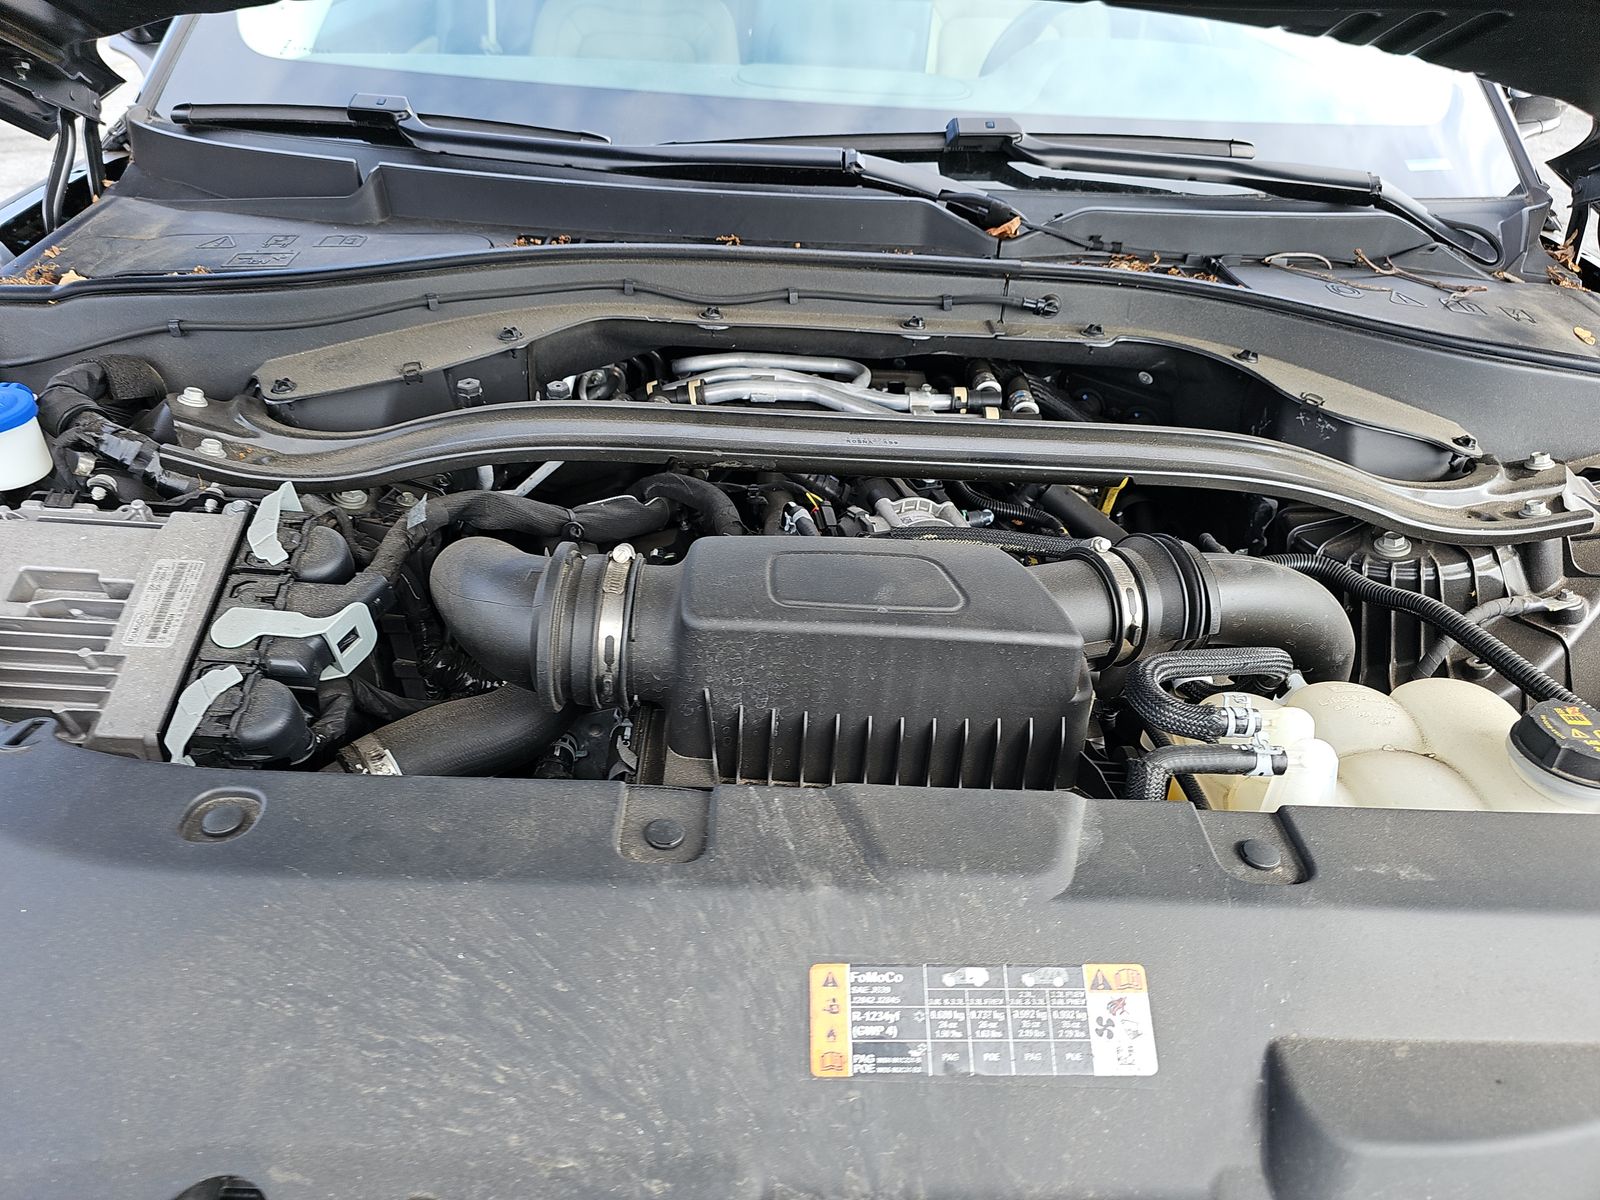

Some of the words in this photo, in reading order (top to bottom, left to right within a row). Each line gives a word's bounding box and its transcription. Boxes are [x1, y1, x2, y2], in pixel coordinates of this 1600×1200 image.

[127, 612, 146, 642] FoMoCo
[162, 613, 176, 634] BOSCH
[850, 971, 904, 983] FoMoCo
[852, 1010, 901, 1023] R-1234yf
[953, 1010, 965, 1021] kg
[993, 1010, 1005, 1021] kg
[1036, 1009, 1048, 1021] kg
[1075, 1010, 1088, 1021] kg
[853, 1025, 884, 1038] (GWP
[885, 1025, 898, 1038] 4)
[853, 1054, 875, 1063] PAG
[853, 1064, 876, 1073] POE
